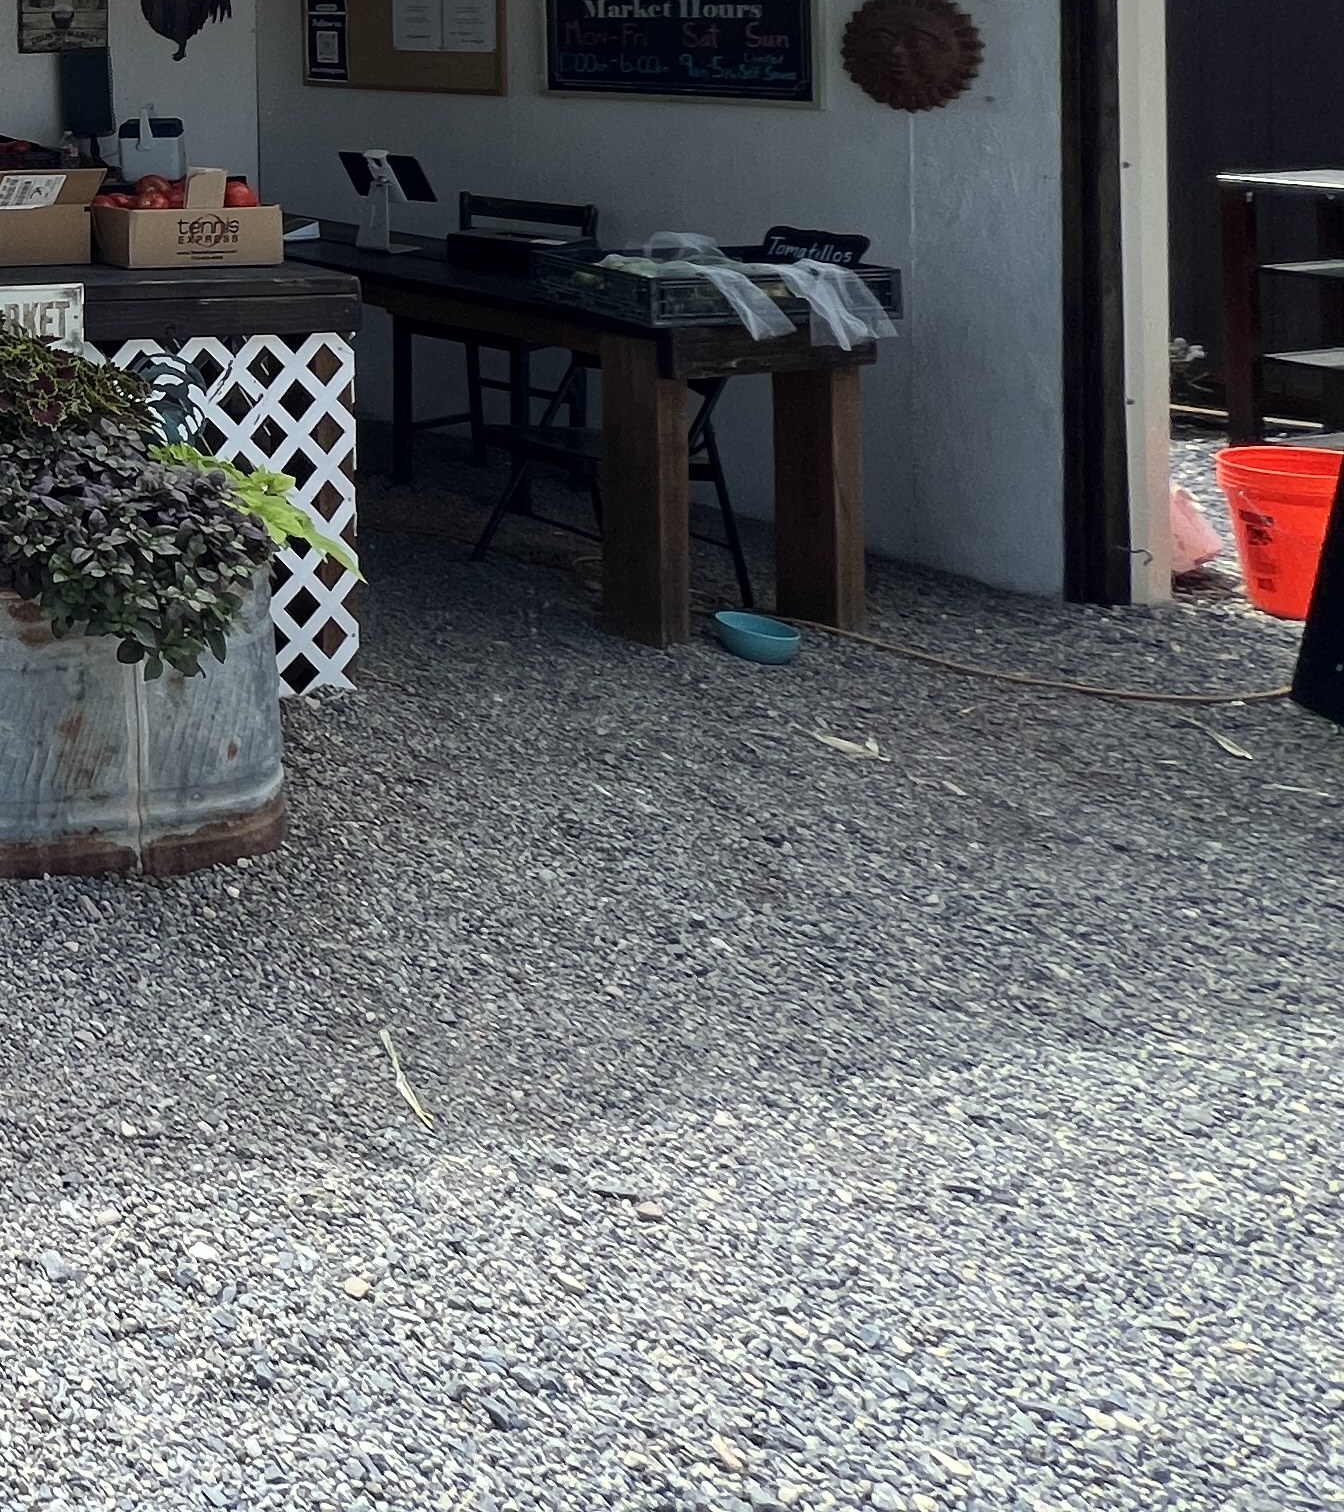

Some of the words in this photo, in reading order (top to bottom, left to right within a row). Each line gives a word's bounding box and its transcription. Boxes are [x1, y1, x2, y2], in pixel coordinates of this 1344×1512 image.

[681, 21, 721, 49] Sat
[745, 20, 791, 49] Sun
[177, 216, 240, 235] tennis
[177, 234, 240, 246] EXPRESS
[766, 234, 854, 264] Tomatillos
